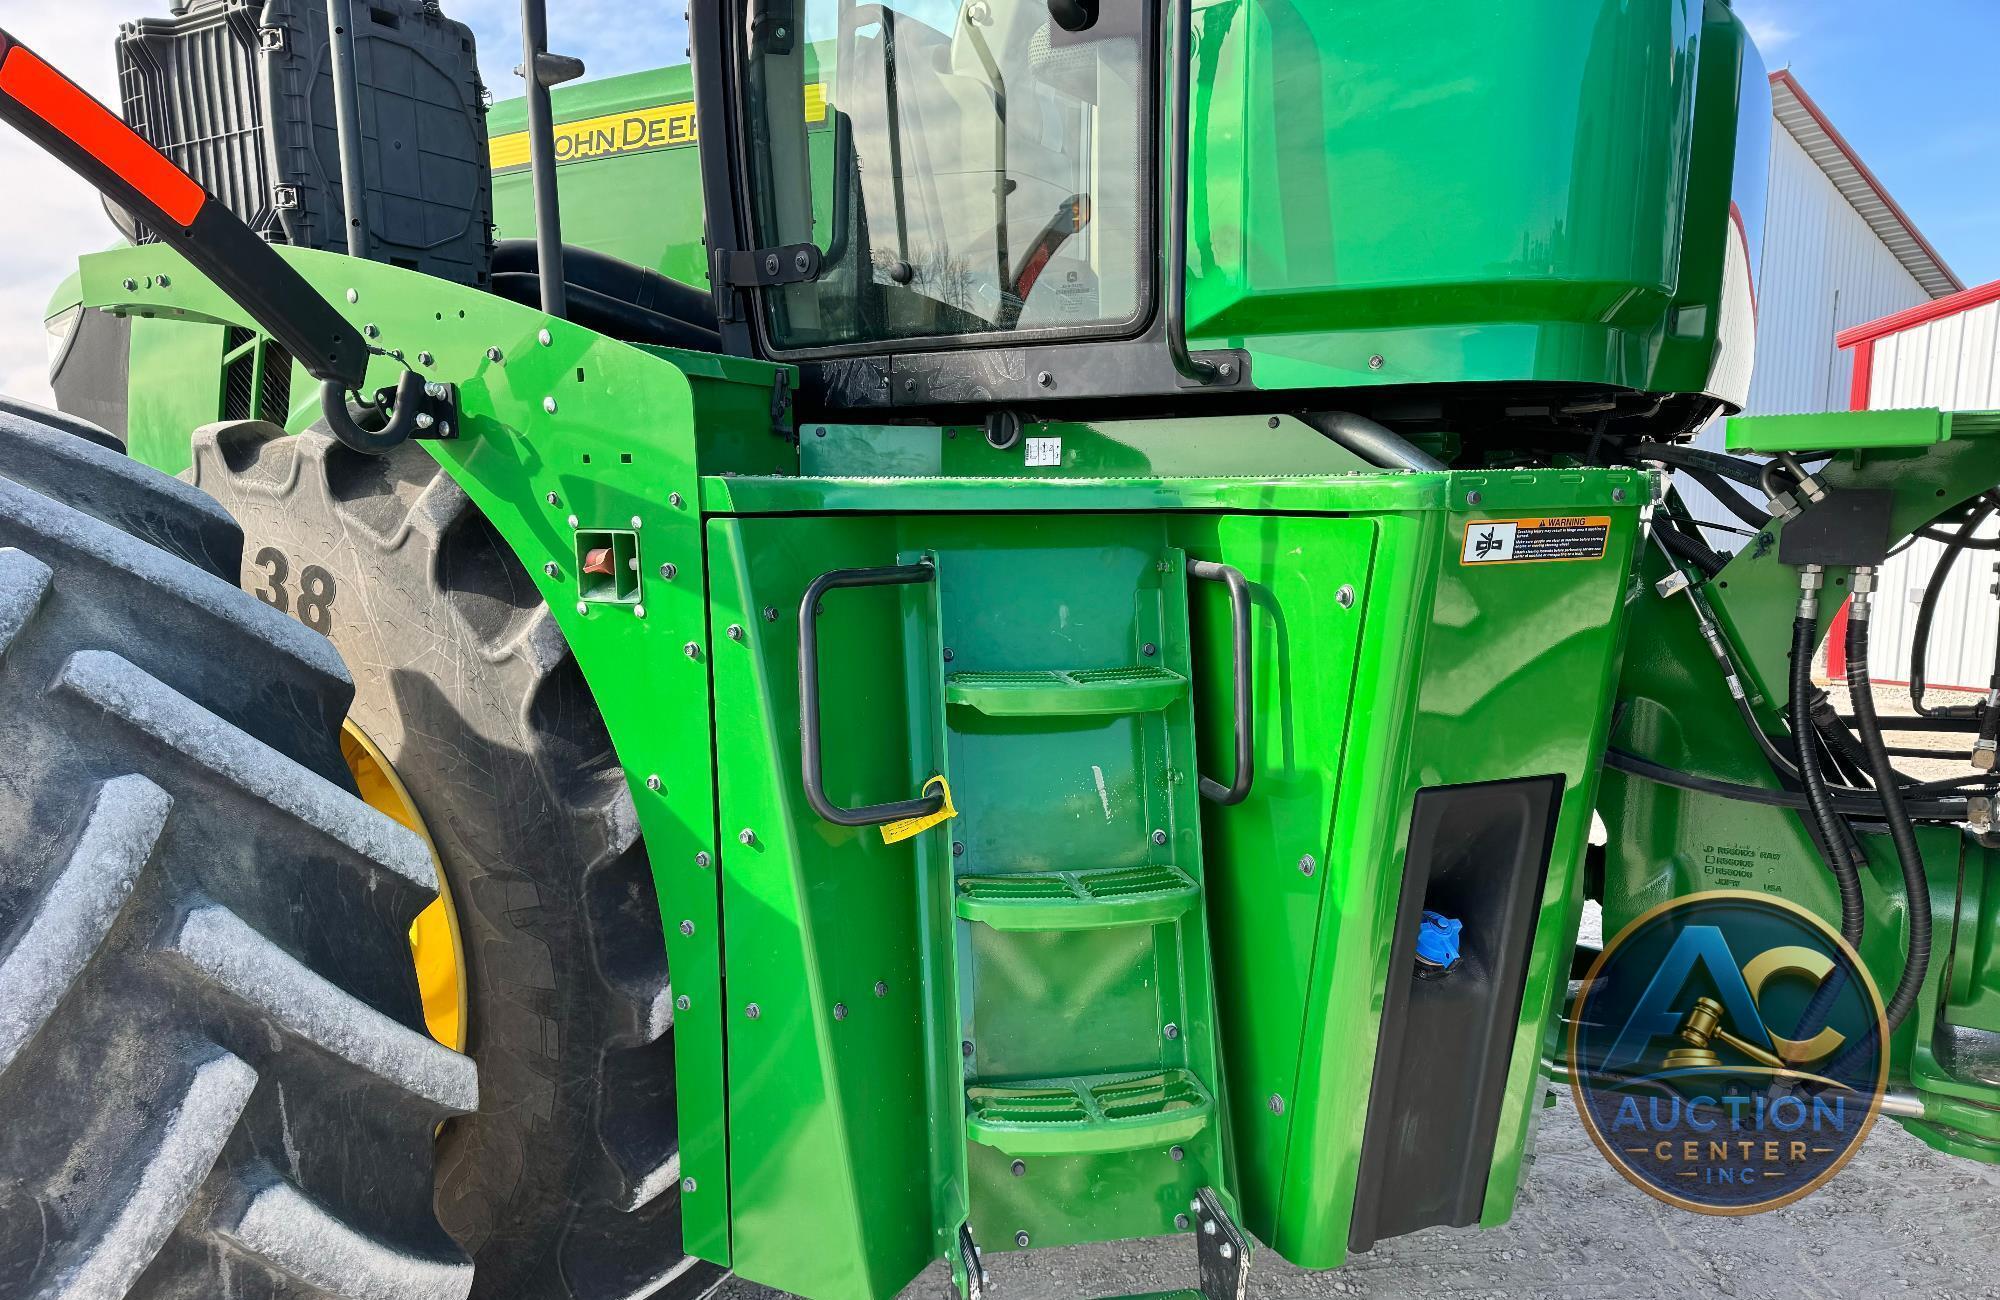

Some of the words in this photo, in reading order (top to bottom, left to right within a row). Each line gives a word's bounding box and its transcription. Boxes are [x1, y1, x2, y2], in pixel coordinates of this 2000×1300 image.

[554, 127, 615, 157] OHN
[1548, 518, 1586, 527] WARNING
[255, 547, 336, 638] 38
[1763, 883, 1782, 892] USA
